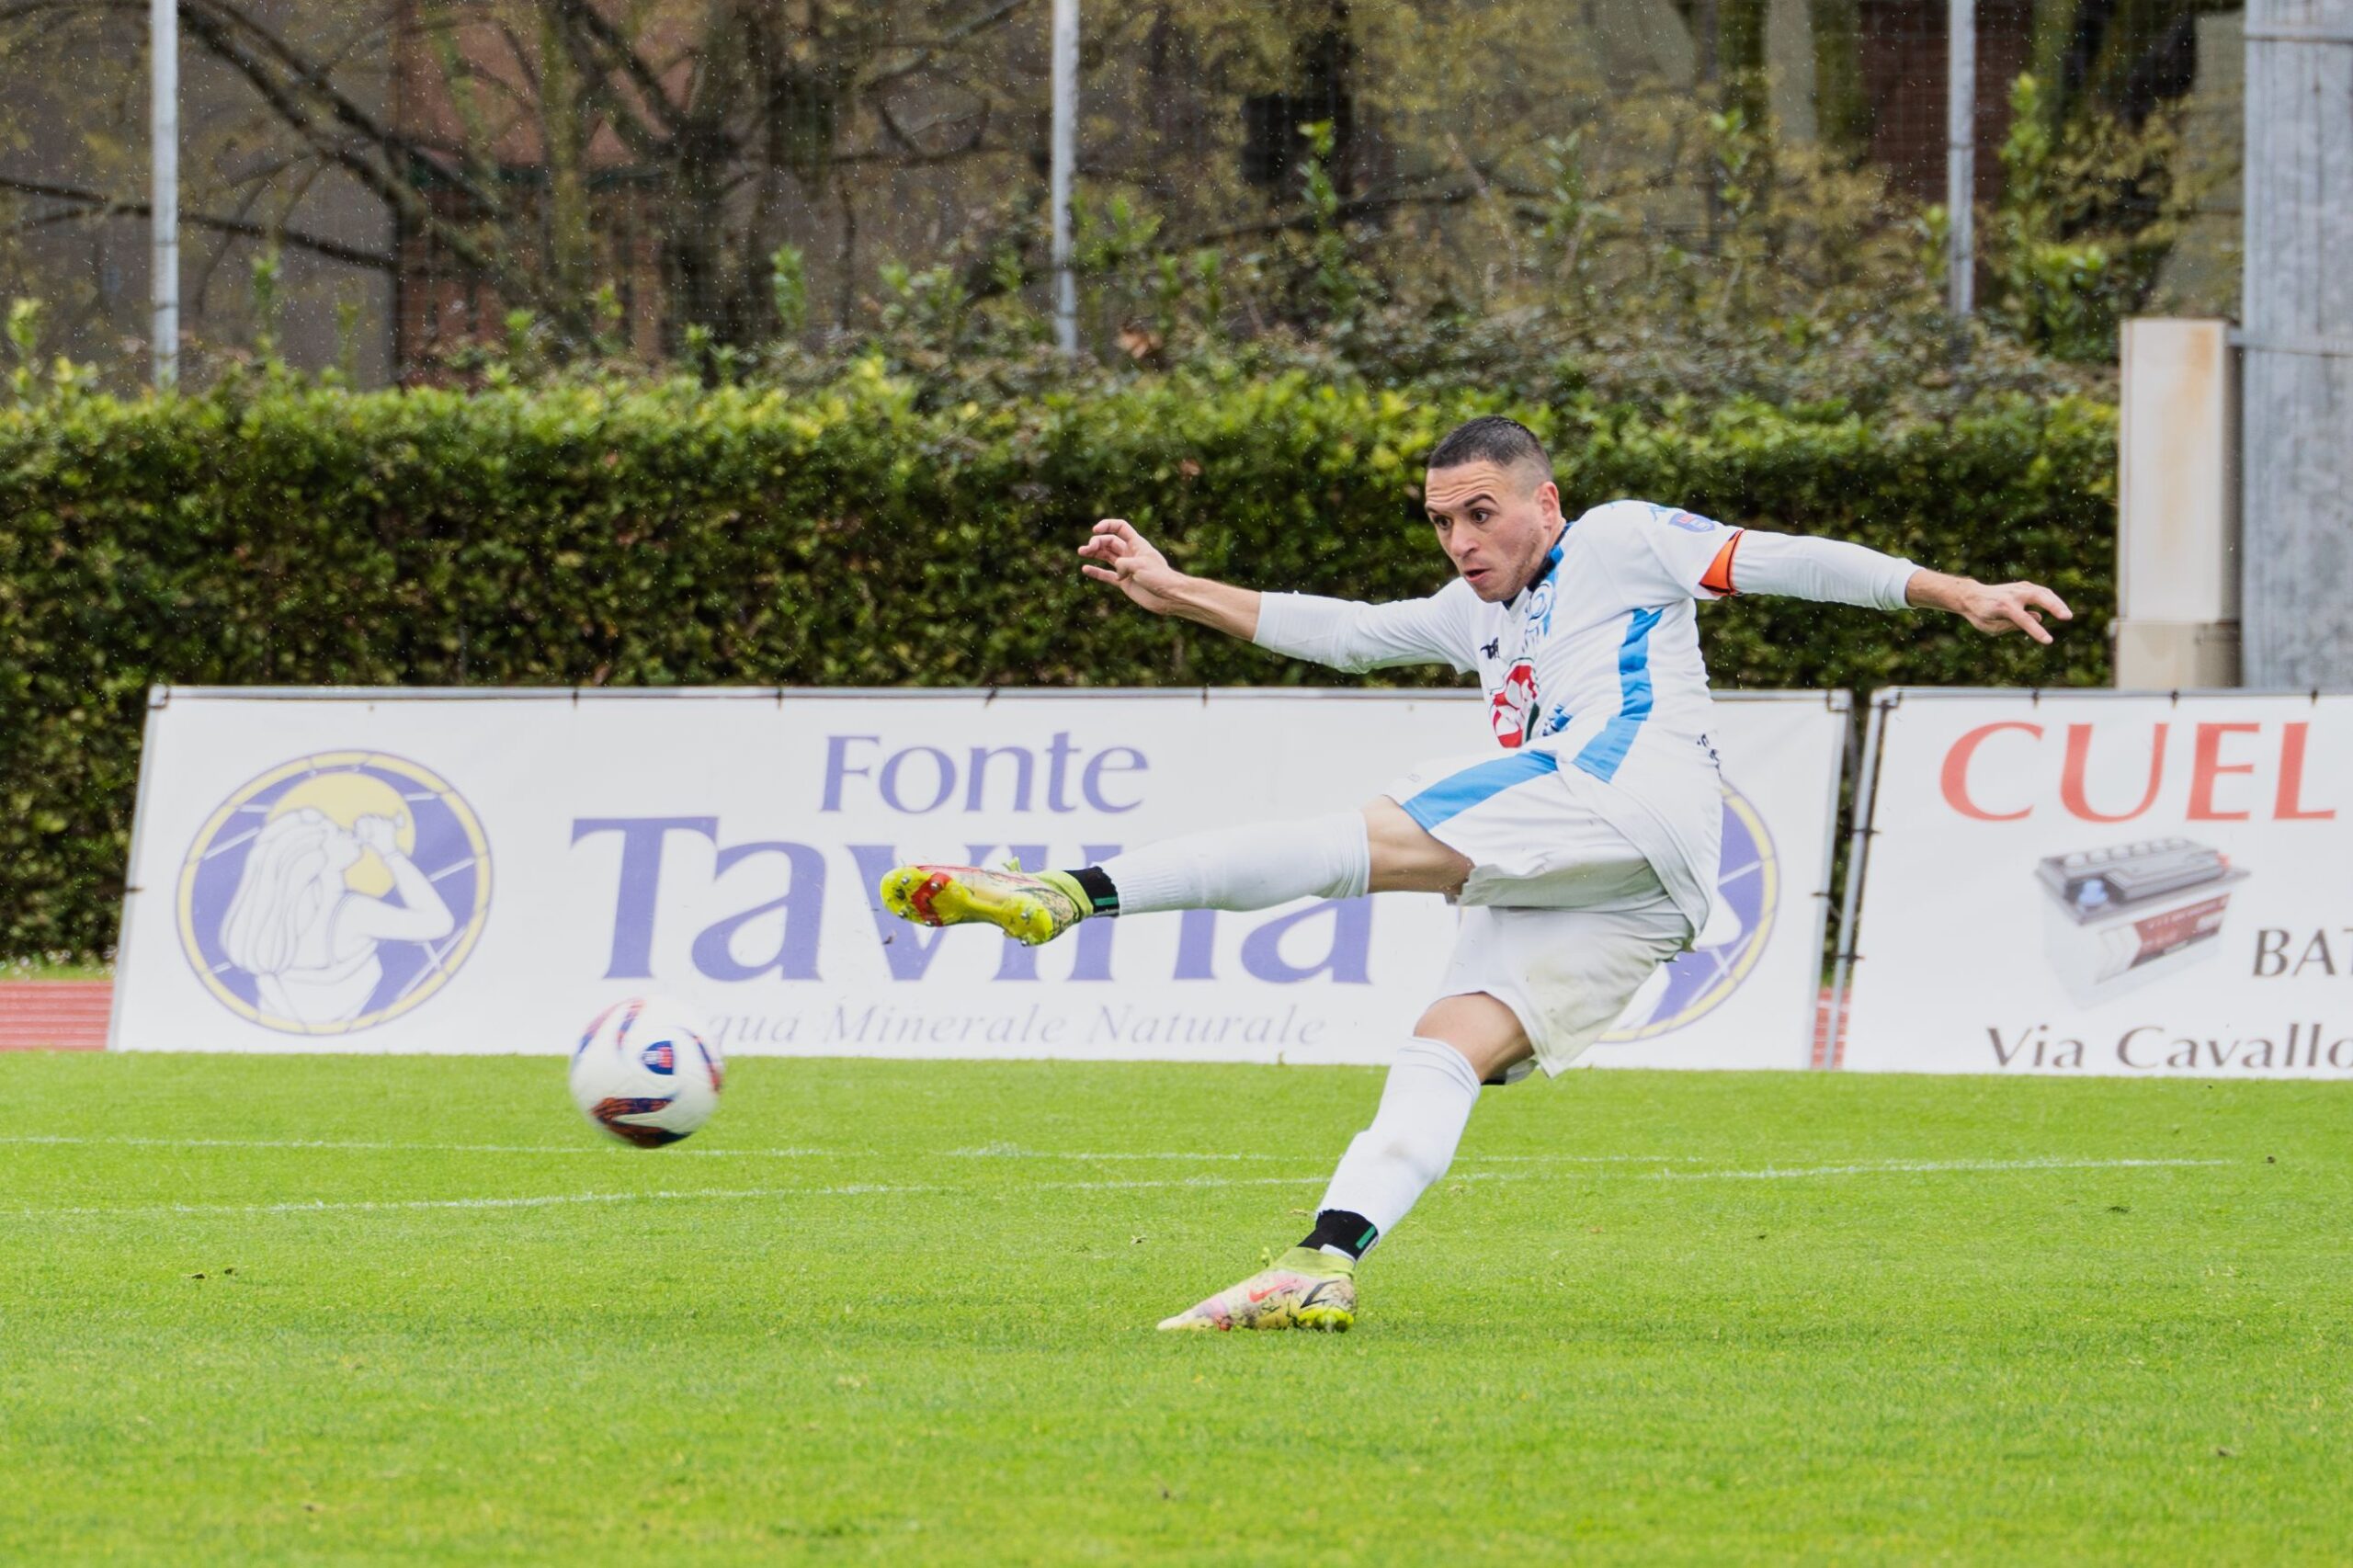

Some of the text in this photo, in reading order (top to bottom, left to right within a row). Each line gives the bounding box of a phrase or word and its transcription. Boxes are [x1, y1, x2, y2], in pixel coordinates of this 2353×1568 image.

[819, 732, 1149, 814] Fonte
[1939, 721, 2336, 823] CUEL
[2252, 928, 2353, 978] BA
[824, 1002, 1067, 1044] Minerale
[1088, 1004, 1326, 1046] Naturale
[1986, 1024, 2085, 1069] Via
